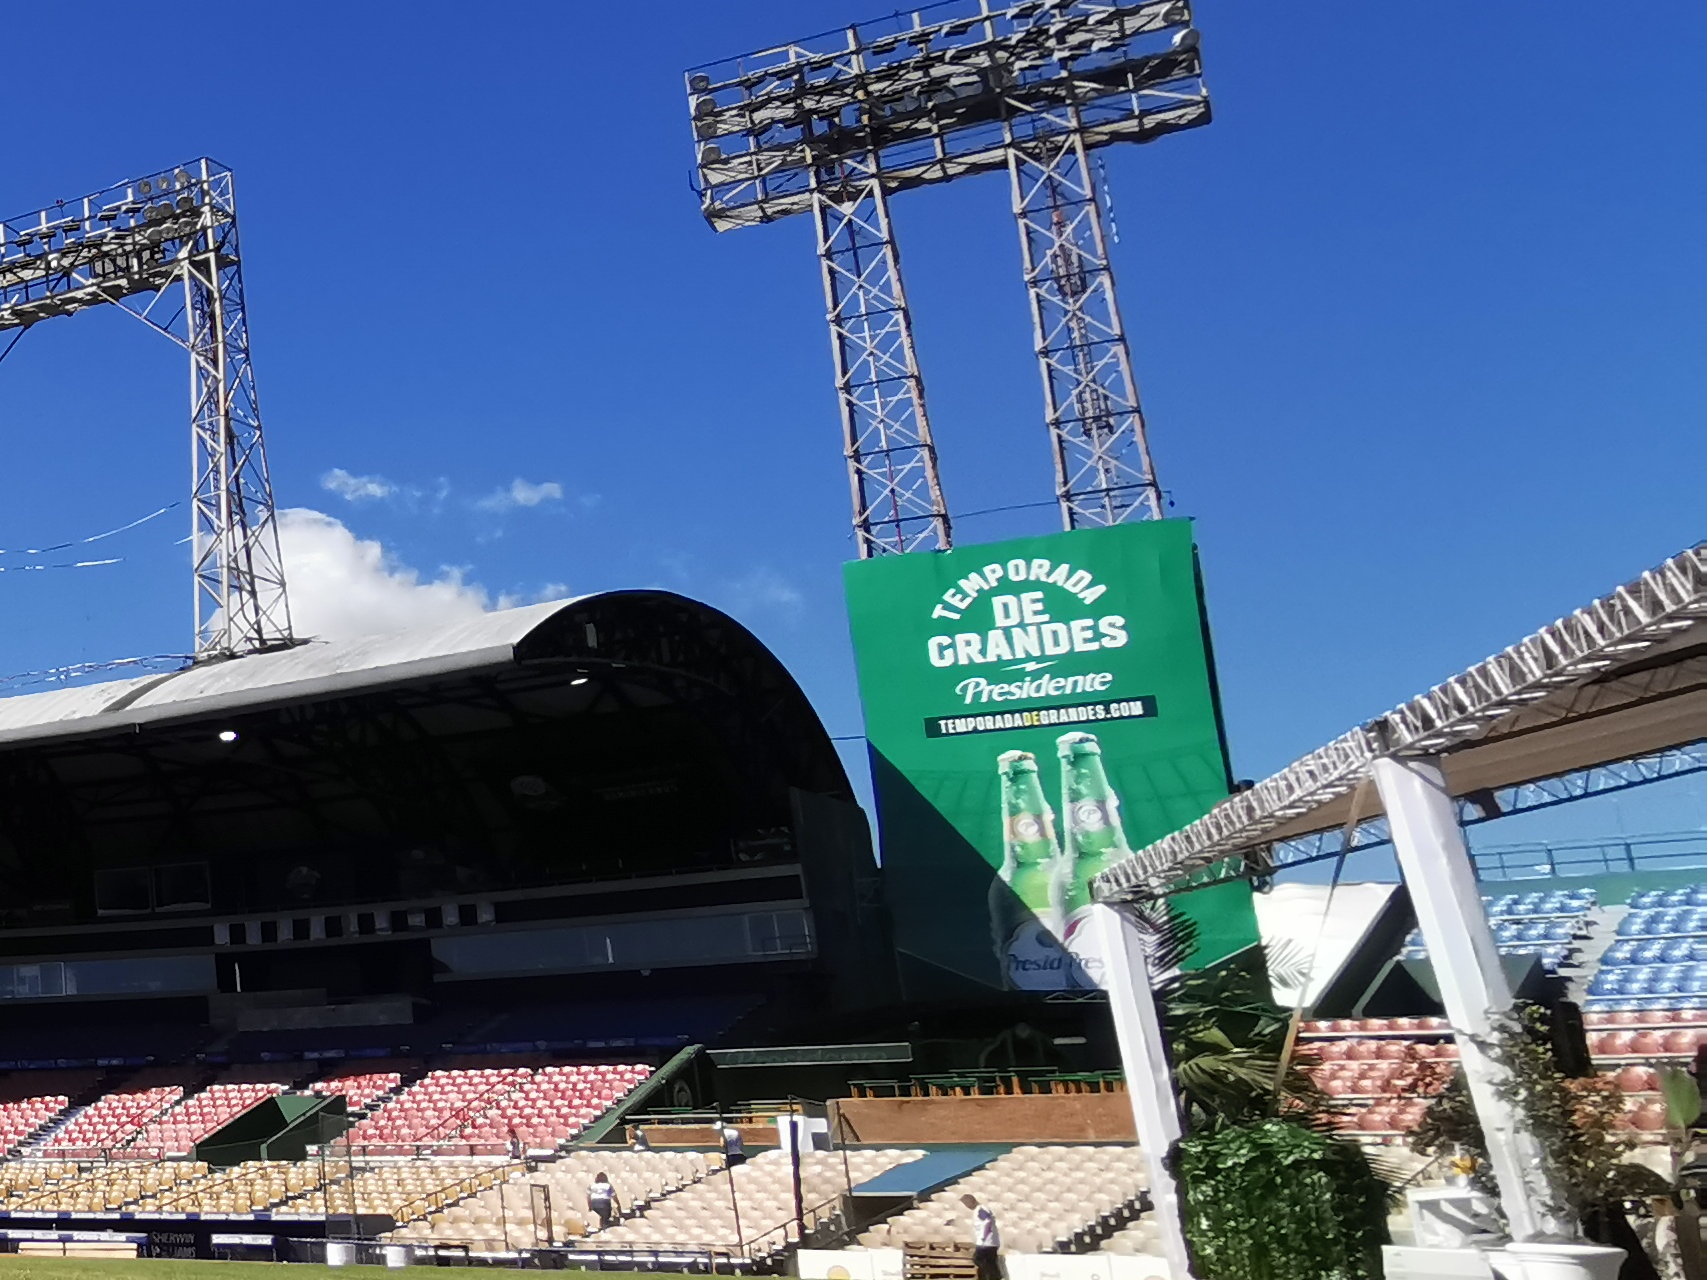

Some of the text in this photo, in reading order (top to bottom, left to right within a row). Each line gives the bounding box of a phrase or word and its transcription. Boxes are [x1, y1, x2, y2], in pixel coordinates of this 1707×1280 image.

[932, 558, 1107, 620] TEMPORADA
[992, 591, 1050, 628] DE
[927, 614, 1128, 668] GRANDES
[955, 671, 1113, 705] Presidente
[938, 701, 1143, 733] TEMPORADADEGRANDES.COM
